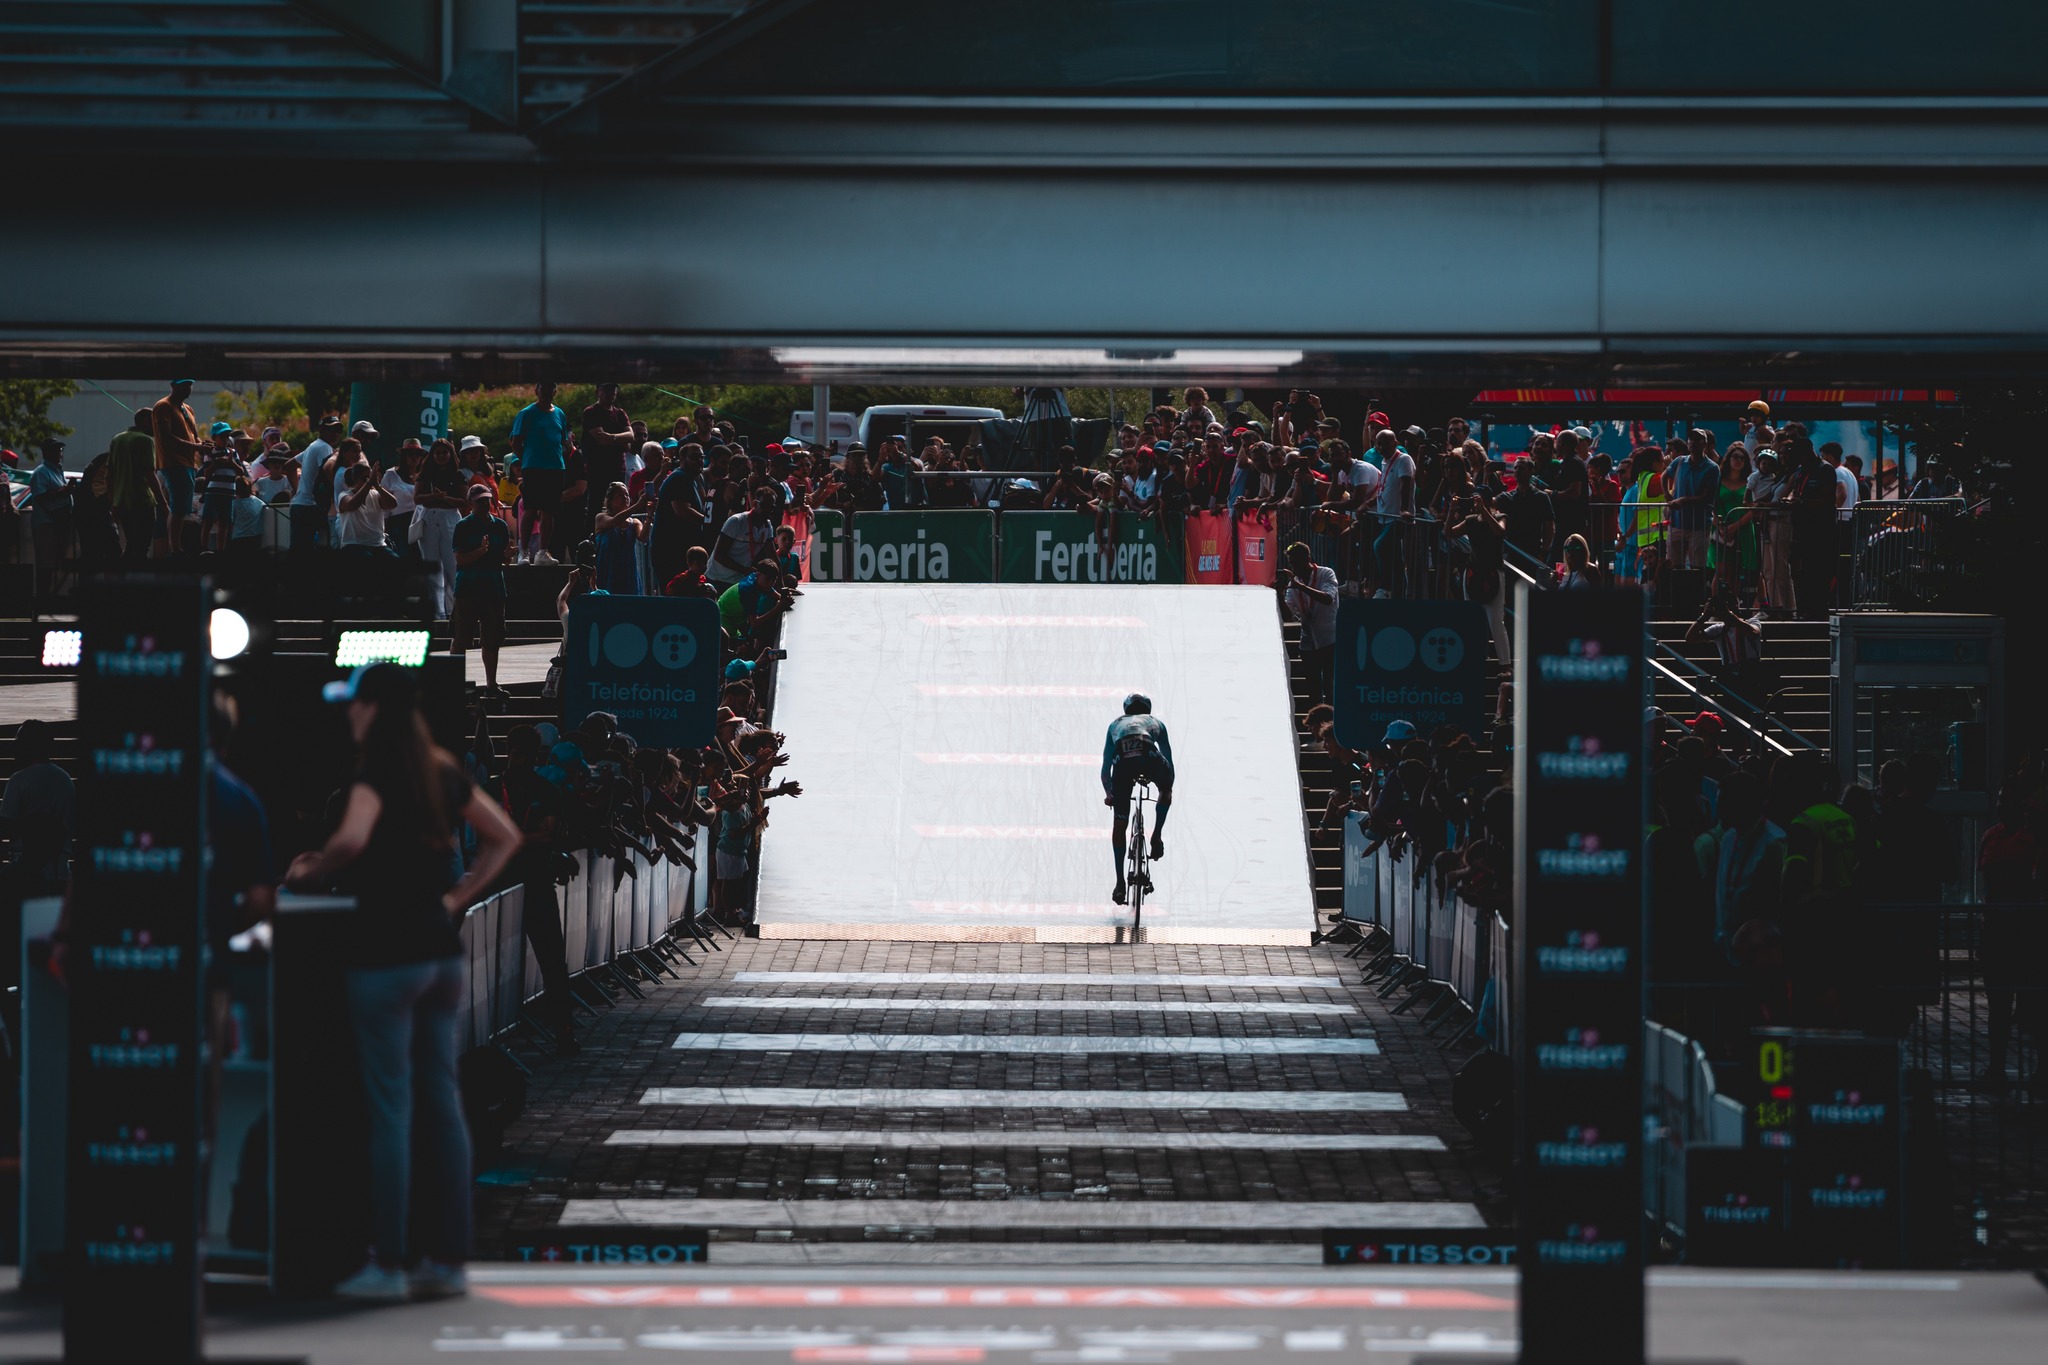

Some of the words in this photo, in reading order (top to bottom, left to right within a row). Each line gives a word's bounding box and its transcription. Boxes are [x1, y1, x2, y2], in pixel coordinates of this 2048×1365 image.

[939, 616, 982, 626] LA
[989, 616, 1127, 626] VUELTA
[587, 682, 696, 703] Telefónica
[937, 686, 982, 696] LA
[989, 686, 1131, 696] VUELTA
[1356, 685, 1463, 705] Telefónica
[649, 708, 677, 720] 1924
[1416, 711, 1445, 722] 1924
[1124, 740, 1142, 752] 122
[937, 753, 982, 763] LA
[990, 754, 1103, 764] VUELT
[936, 827, 982, 837] LA
[992, 827, 1112, 838] VUELT
[934, 902, 982, 913] LA
[1808, 1104, 1887, 1124] TISSOT
[1808, 1188, 1887, 1208] TISSOT
[1701, 1206, 1771, 1223] TISSOT
[567, 1244, 700, 1264] TISSOT
[1383, 1243, 1517, 1264] TISSOT
